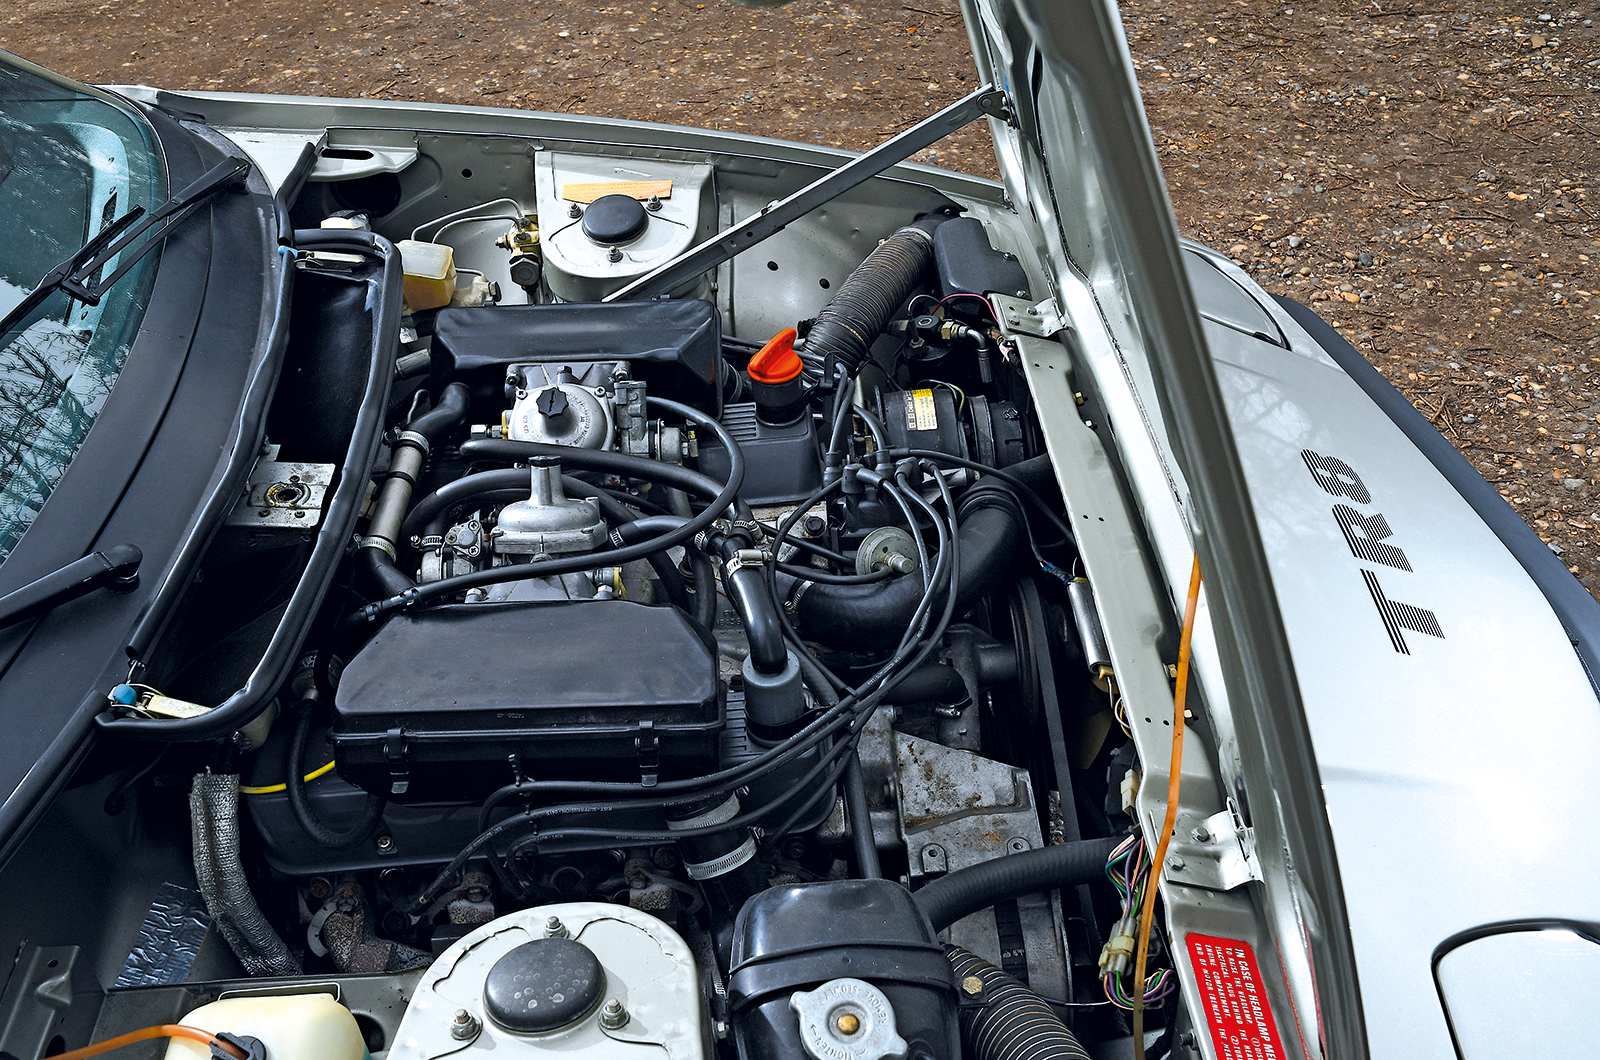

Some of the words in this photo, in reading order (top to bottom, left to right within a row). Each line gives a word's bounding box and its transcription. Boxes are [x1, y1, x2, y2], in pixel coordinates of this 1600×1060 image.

[1301, 450, 1446, 656] TR8
[1205, 945, 1216, 965] ENGINE
[1235, 948, 1245, 958] IN
[1228, 958, 1238, 973] RAISE
[1234, 978, 1242, 987] THE
[1239, 962, 1252, 980] CASE
[825, 985, 859, 1001] SLOWLY
[1195, 943, 1203, 955] END
[1200, 957, 1207, 966] OF
[1219, 1029, 1227, 1039] THE
[1215, 947, 1230, 977] ELECTRICAL
[1226, 983, 1236, 997] PLUG
[1231, 1001, 1243, 1024] BEHIND
[1239, 1030, 1248, 1040] THE
[1246, 983, 1256, 993] OF
[866, 991, 889, 1024] REMOVE
[1249, 995, 1270, 1041] HEADLAMP
[815, 1037, 855, 1060] TIGHTEN
